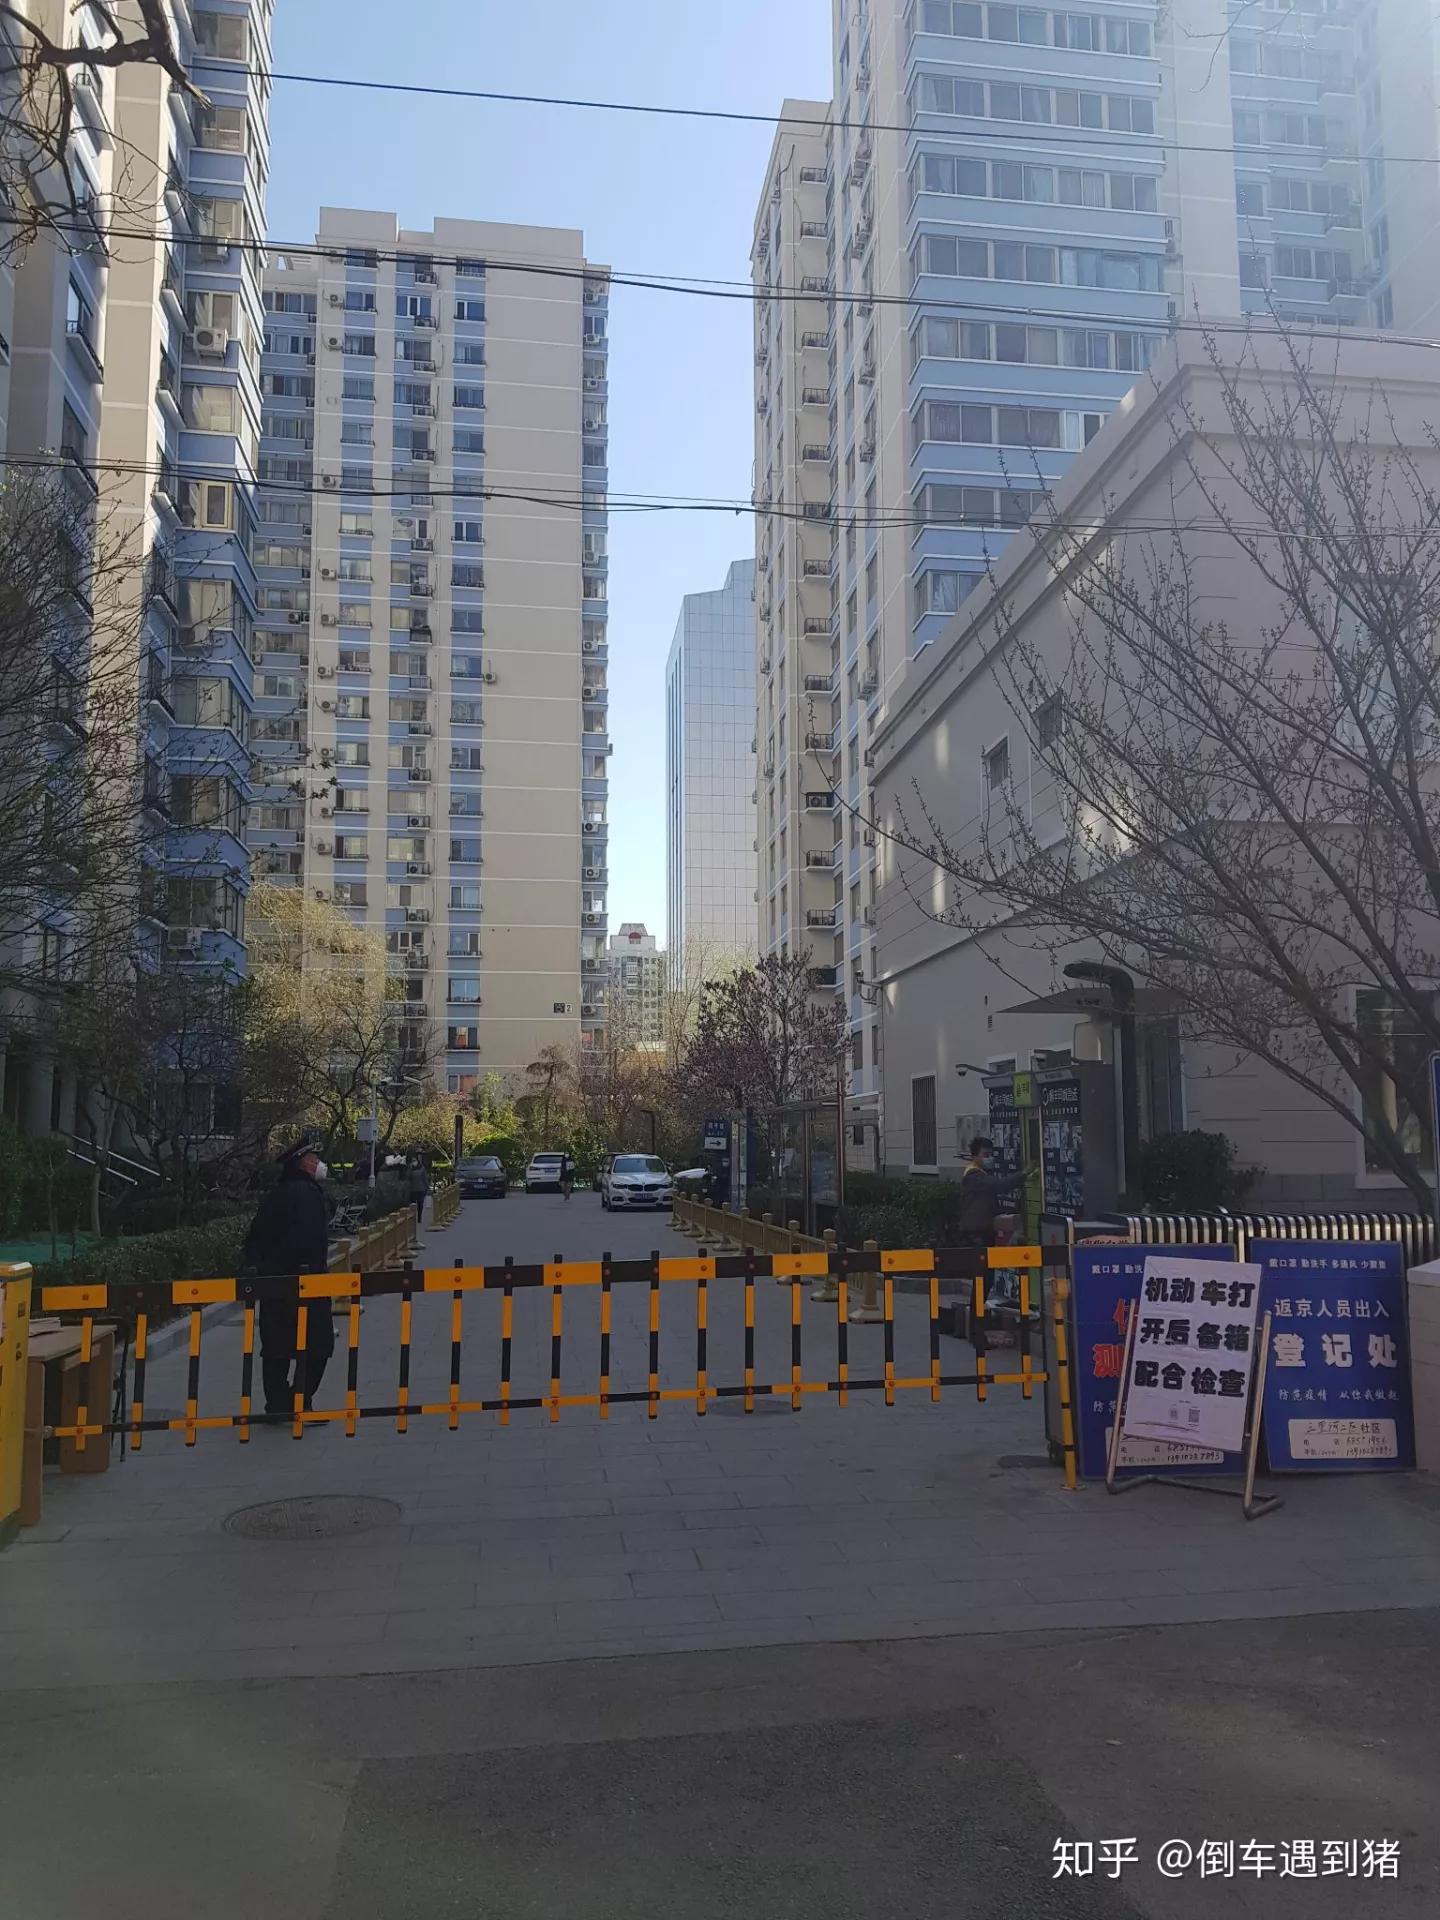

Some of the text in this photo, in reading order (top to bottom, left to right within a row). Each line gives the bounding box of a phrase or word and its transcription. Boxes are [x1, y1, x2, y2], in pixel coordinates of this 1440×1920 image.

[1145, 1276, 1256, 1308] 机动车打
[1274, 1298, 1390, 1318] 返京人员出入
[1140, 1318, 1250, 1351] 开后备箱
[1273, 1333, 1397, 1368] 登记处
[1134, 1360, 1246, 1398] 配合检查
